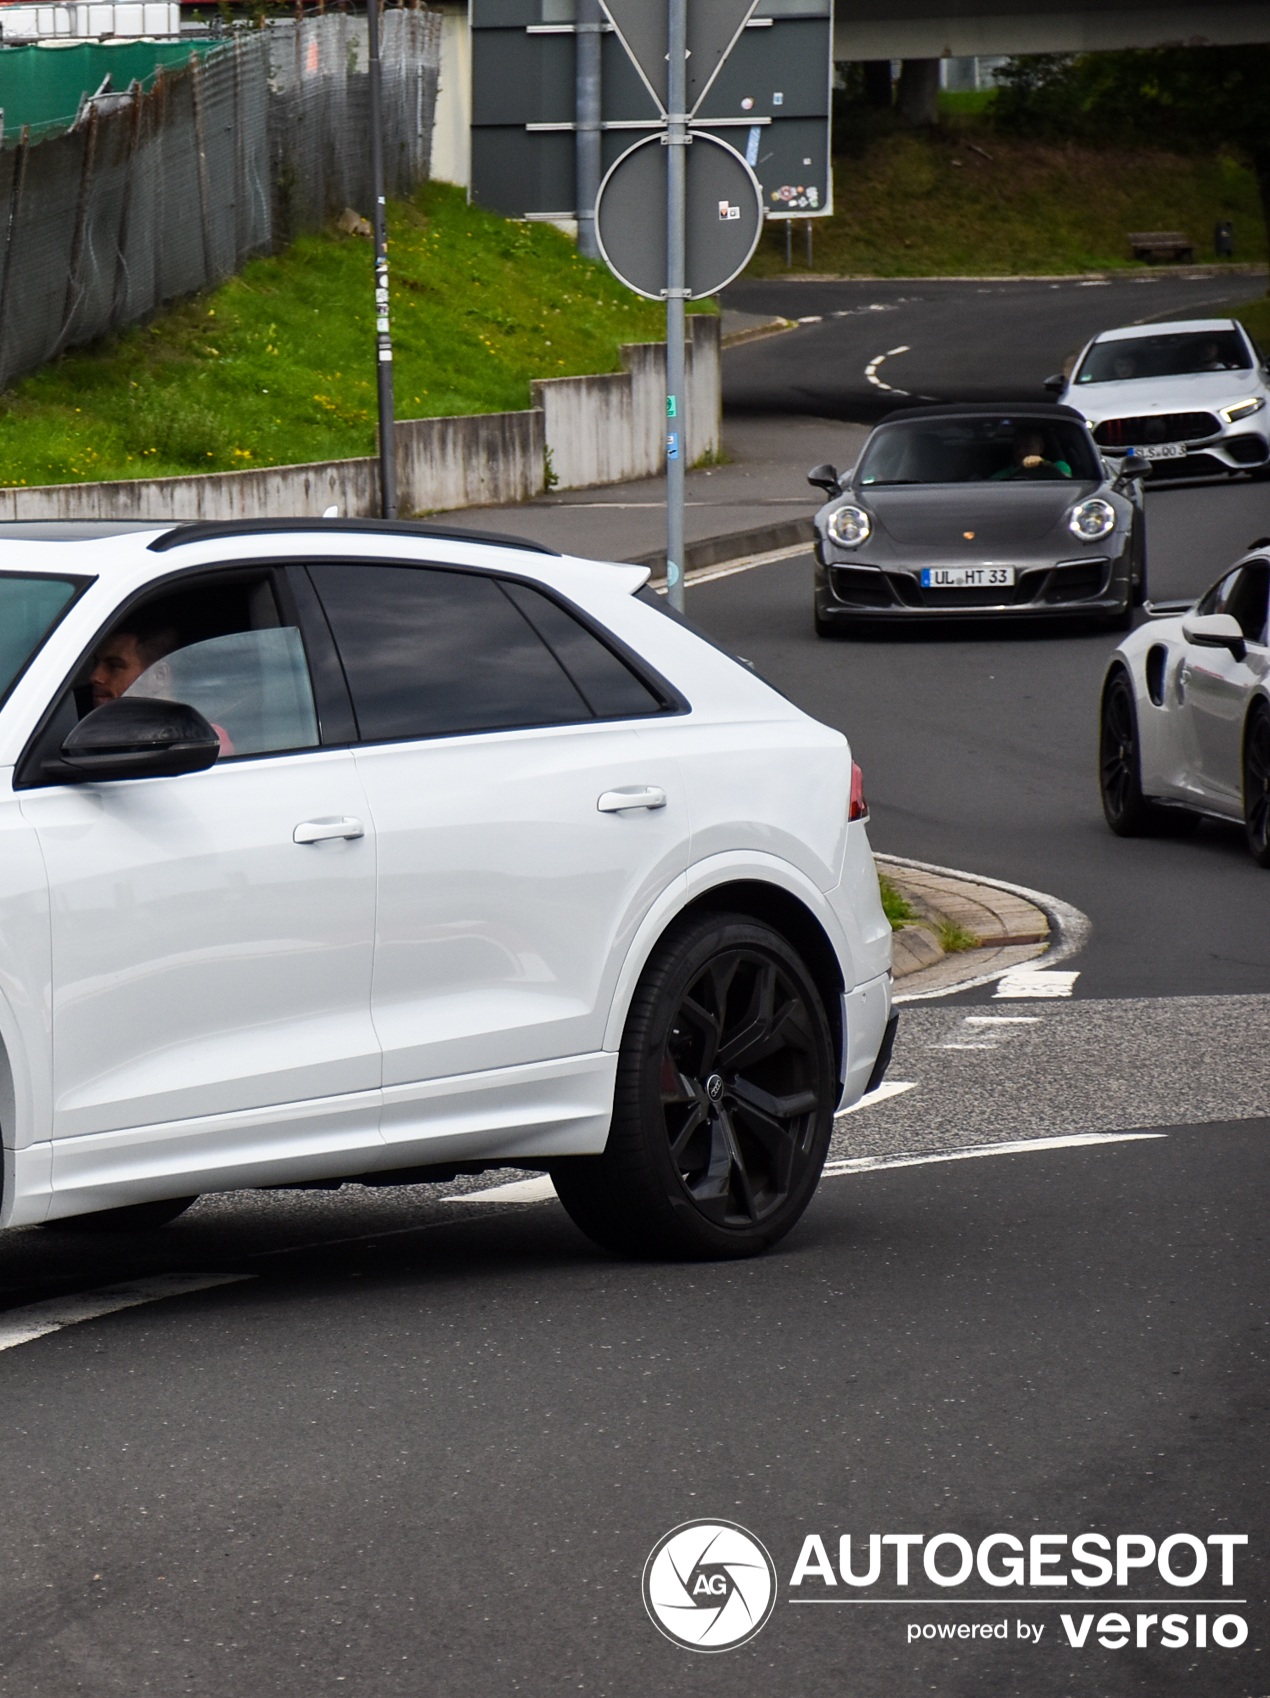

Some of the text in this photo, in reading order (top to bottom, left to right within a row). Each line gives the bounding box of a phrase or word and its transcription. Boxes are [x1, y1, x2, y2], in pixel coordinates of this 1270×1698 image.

[935, 569, 1007, 585] UL HT 33
